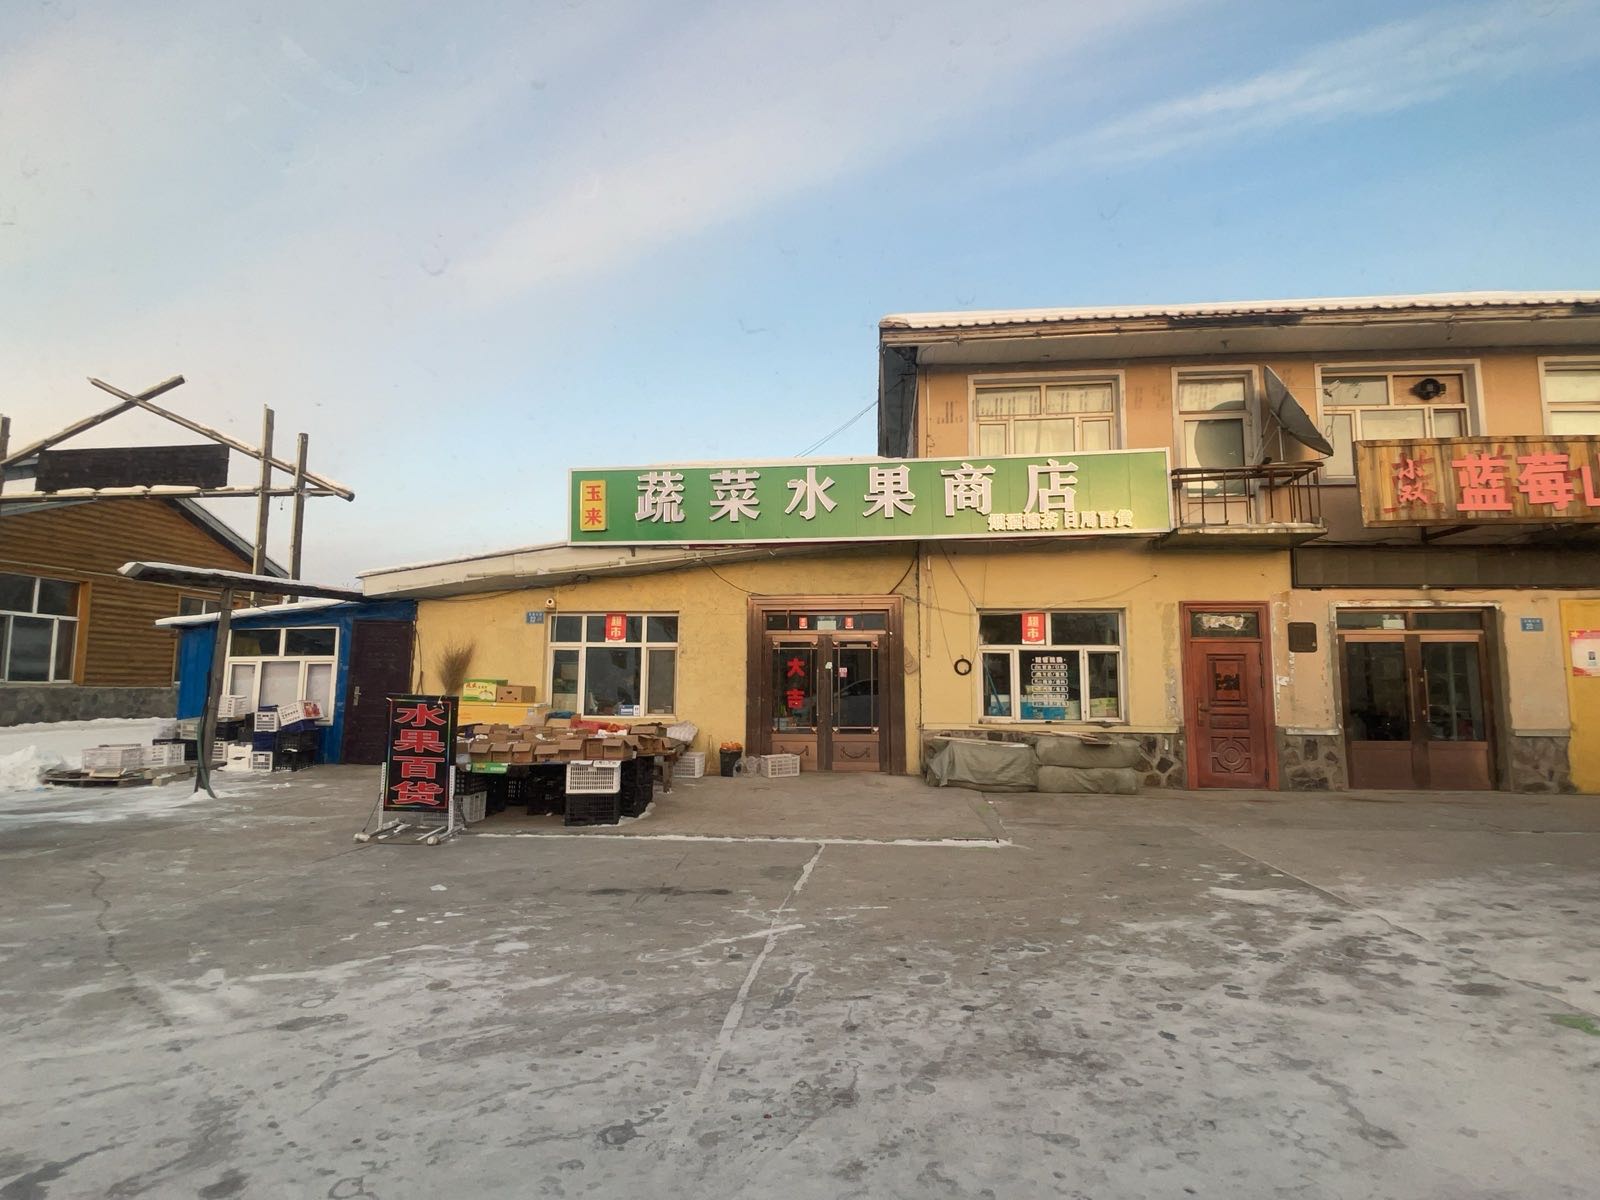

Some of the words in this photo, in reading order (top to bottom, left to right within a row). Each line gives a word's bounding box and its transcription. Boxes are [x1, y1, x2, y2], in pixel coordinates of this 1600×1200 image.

[585, 485, 603, 525] 玉来
[635, 458, 1079, 523] 蔬菜水果商店
[1064, 509, 1134, 529] 日用百货
[611, 616, 622, 637] 超市
[1027, 616, 1039, 638] 超市
[786, 657, 806, 710] 大吉
[390, 703, 447, 806] 水果百货
